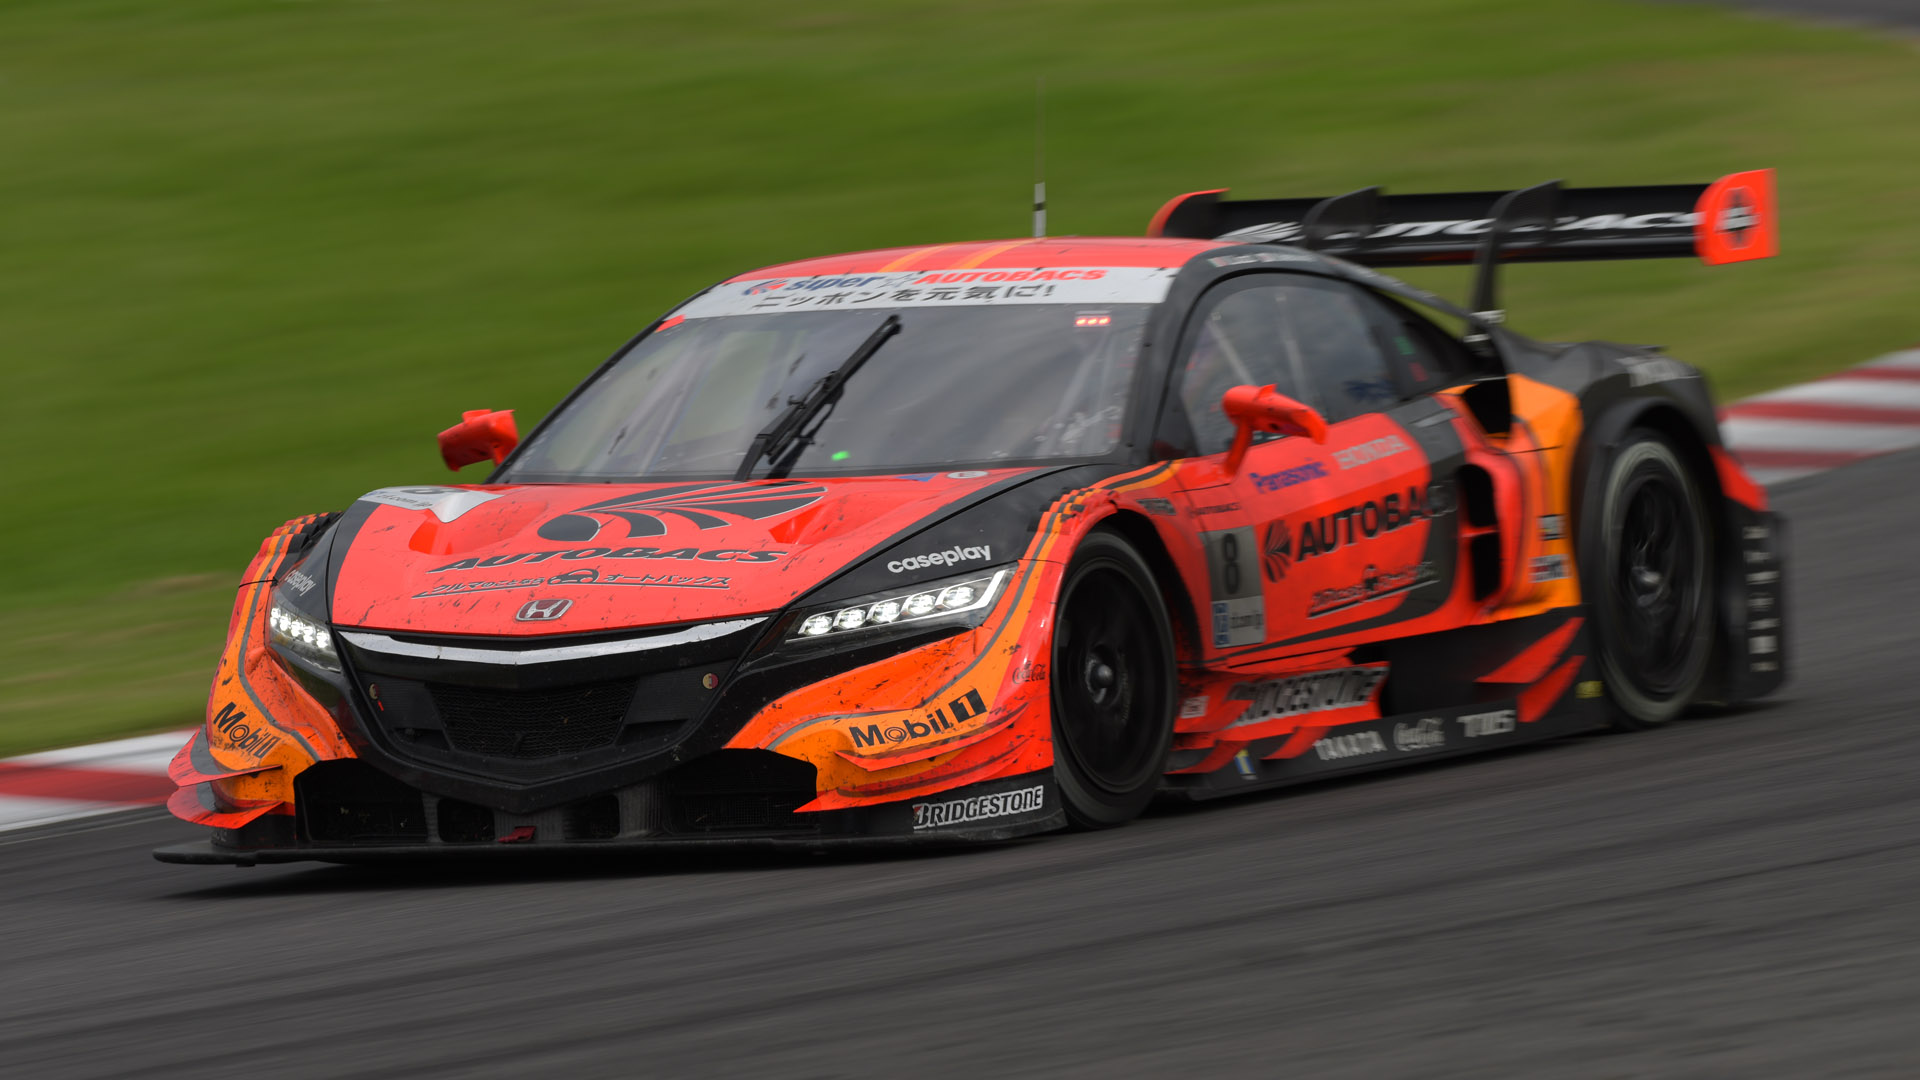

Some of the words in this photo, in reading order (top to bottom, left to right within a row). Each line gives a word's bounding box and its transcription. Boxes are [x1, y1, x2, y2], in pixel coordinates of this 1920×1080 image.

[912, 269, 1109, 285] AUTOBACS
[425, 547, 788, 573] AUTOBACS
[887, 544, 992, 574] caseplay
[1221, 532, 1241, 596] 8
[284, 569, 316, 597] caseplay
[604, 573, 732, 587] オートバックス
[213, 701, 272, 753] Mobil
[848, 708, 951, 748] Mobil
[914, 786, 1043, 828] BRIDGESTONE
